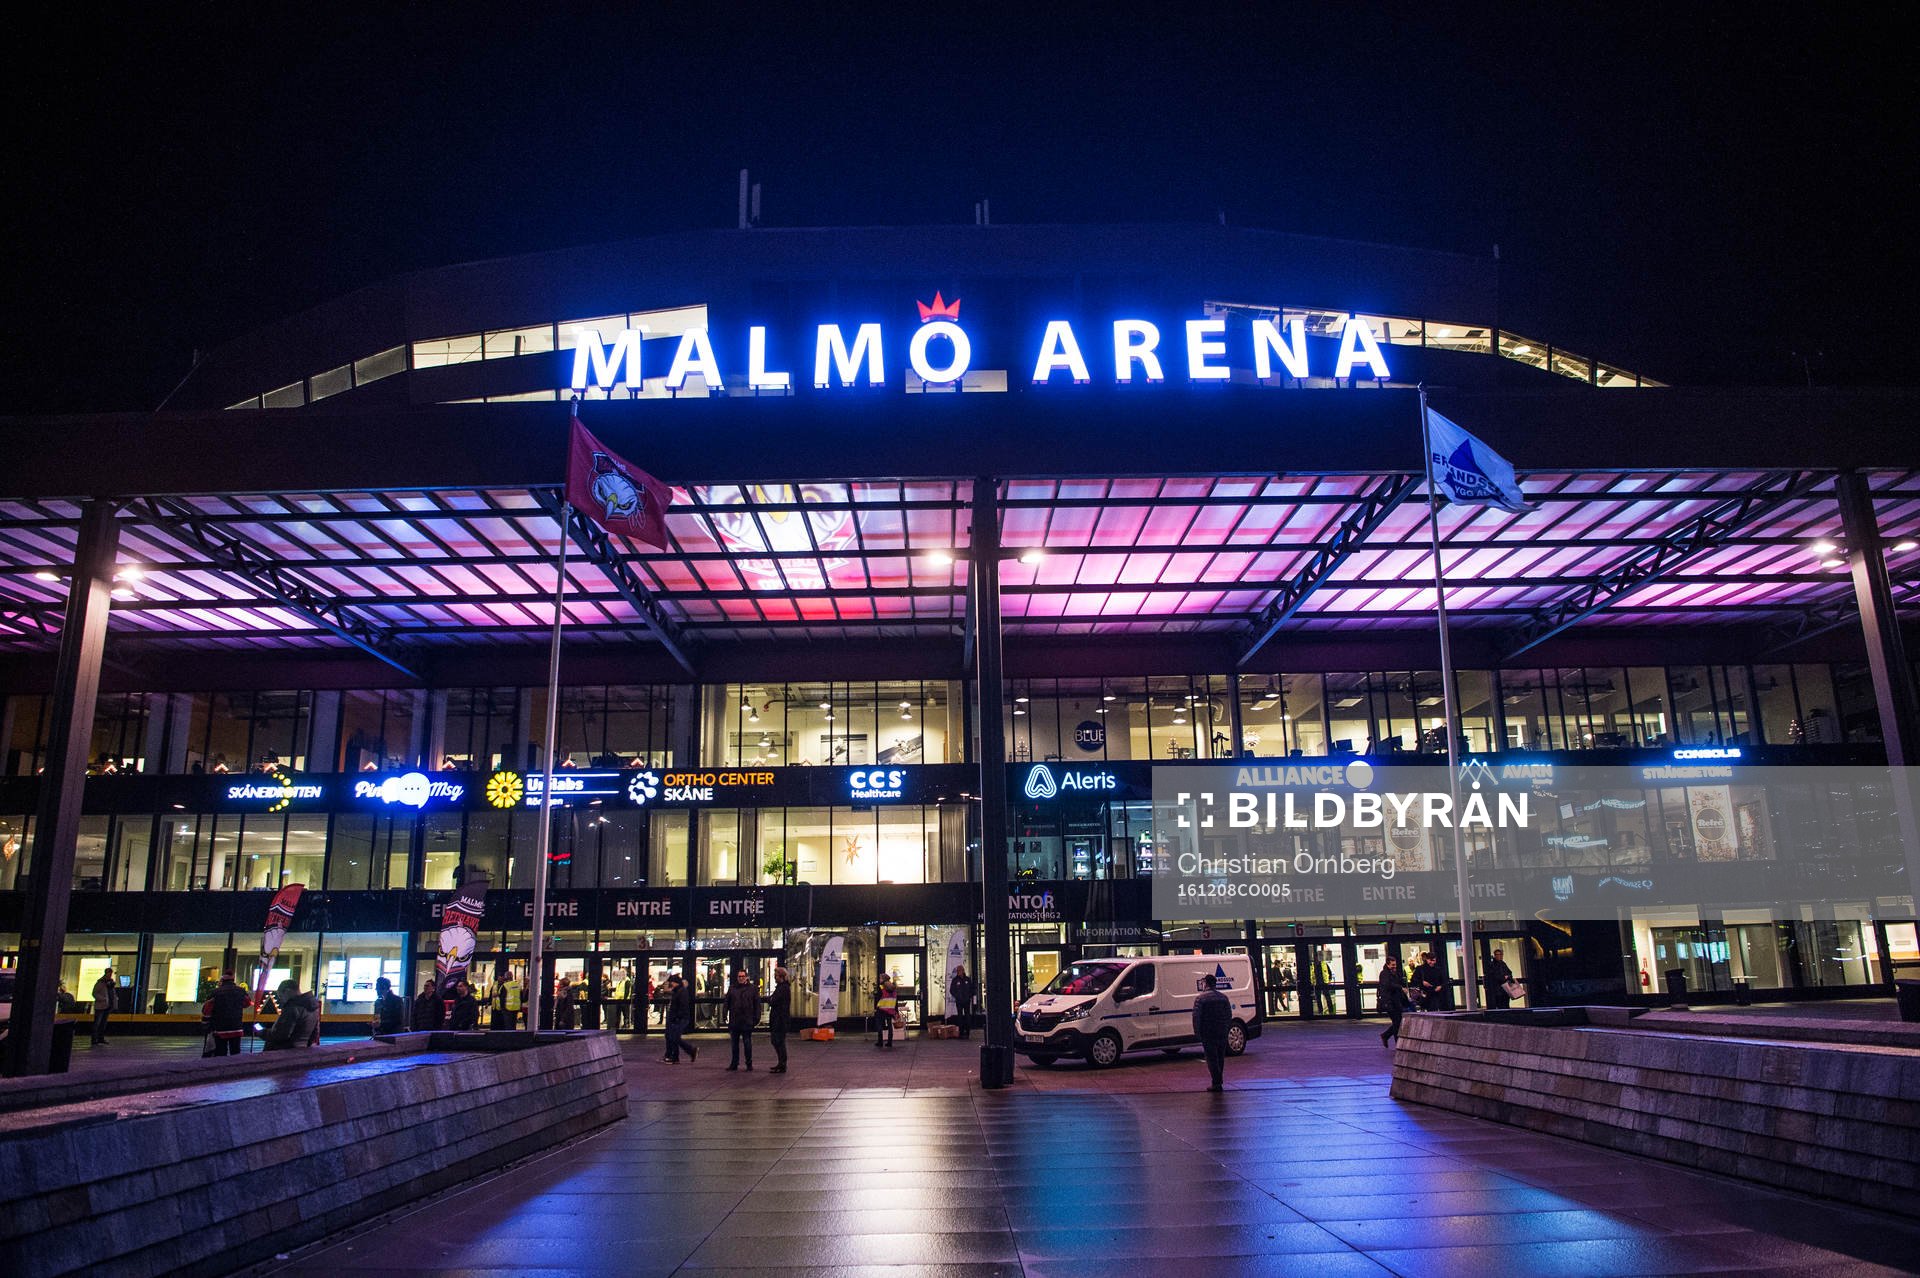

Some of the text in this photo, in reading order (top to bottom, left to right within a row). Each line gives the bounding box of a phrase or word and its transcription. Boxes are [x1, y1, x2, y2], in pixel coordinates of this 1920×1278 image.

[1032, 318, 1391, 383] ARENA
[663, 772, 775, 786] ORTHO CENTER
[1061, 771, 1116, 790] Aleris
[1236, 766, 1344, 786] ALLIANCE
[664, 785, 714, 801] SKÅNE
[851, 789, 902, 798] Healthcare
[1076, 927, 1141, 937] INFORMATION
[1202, 925, 1210, 939] 5
[1296, 923, 1304, 937] 6
[1387, 920, 1395, 934] 7
[637, 935, 647, 949] 3
